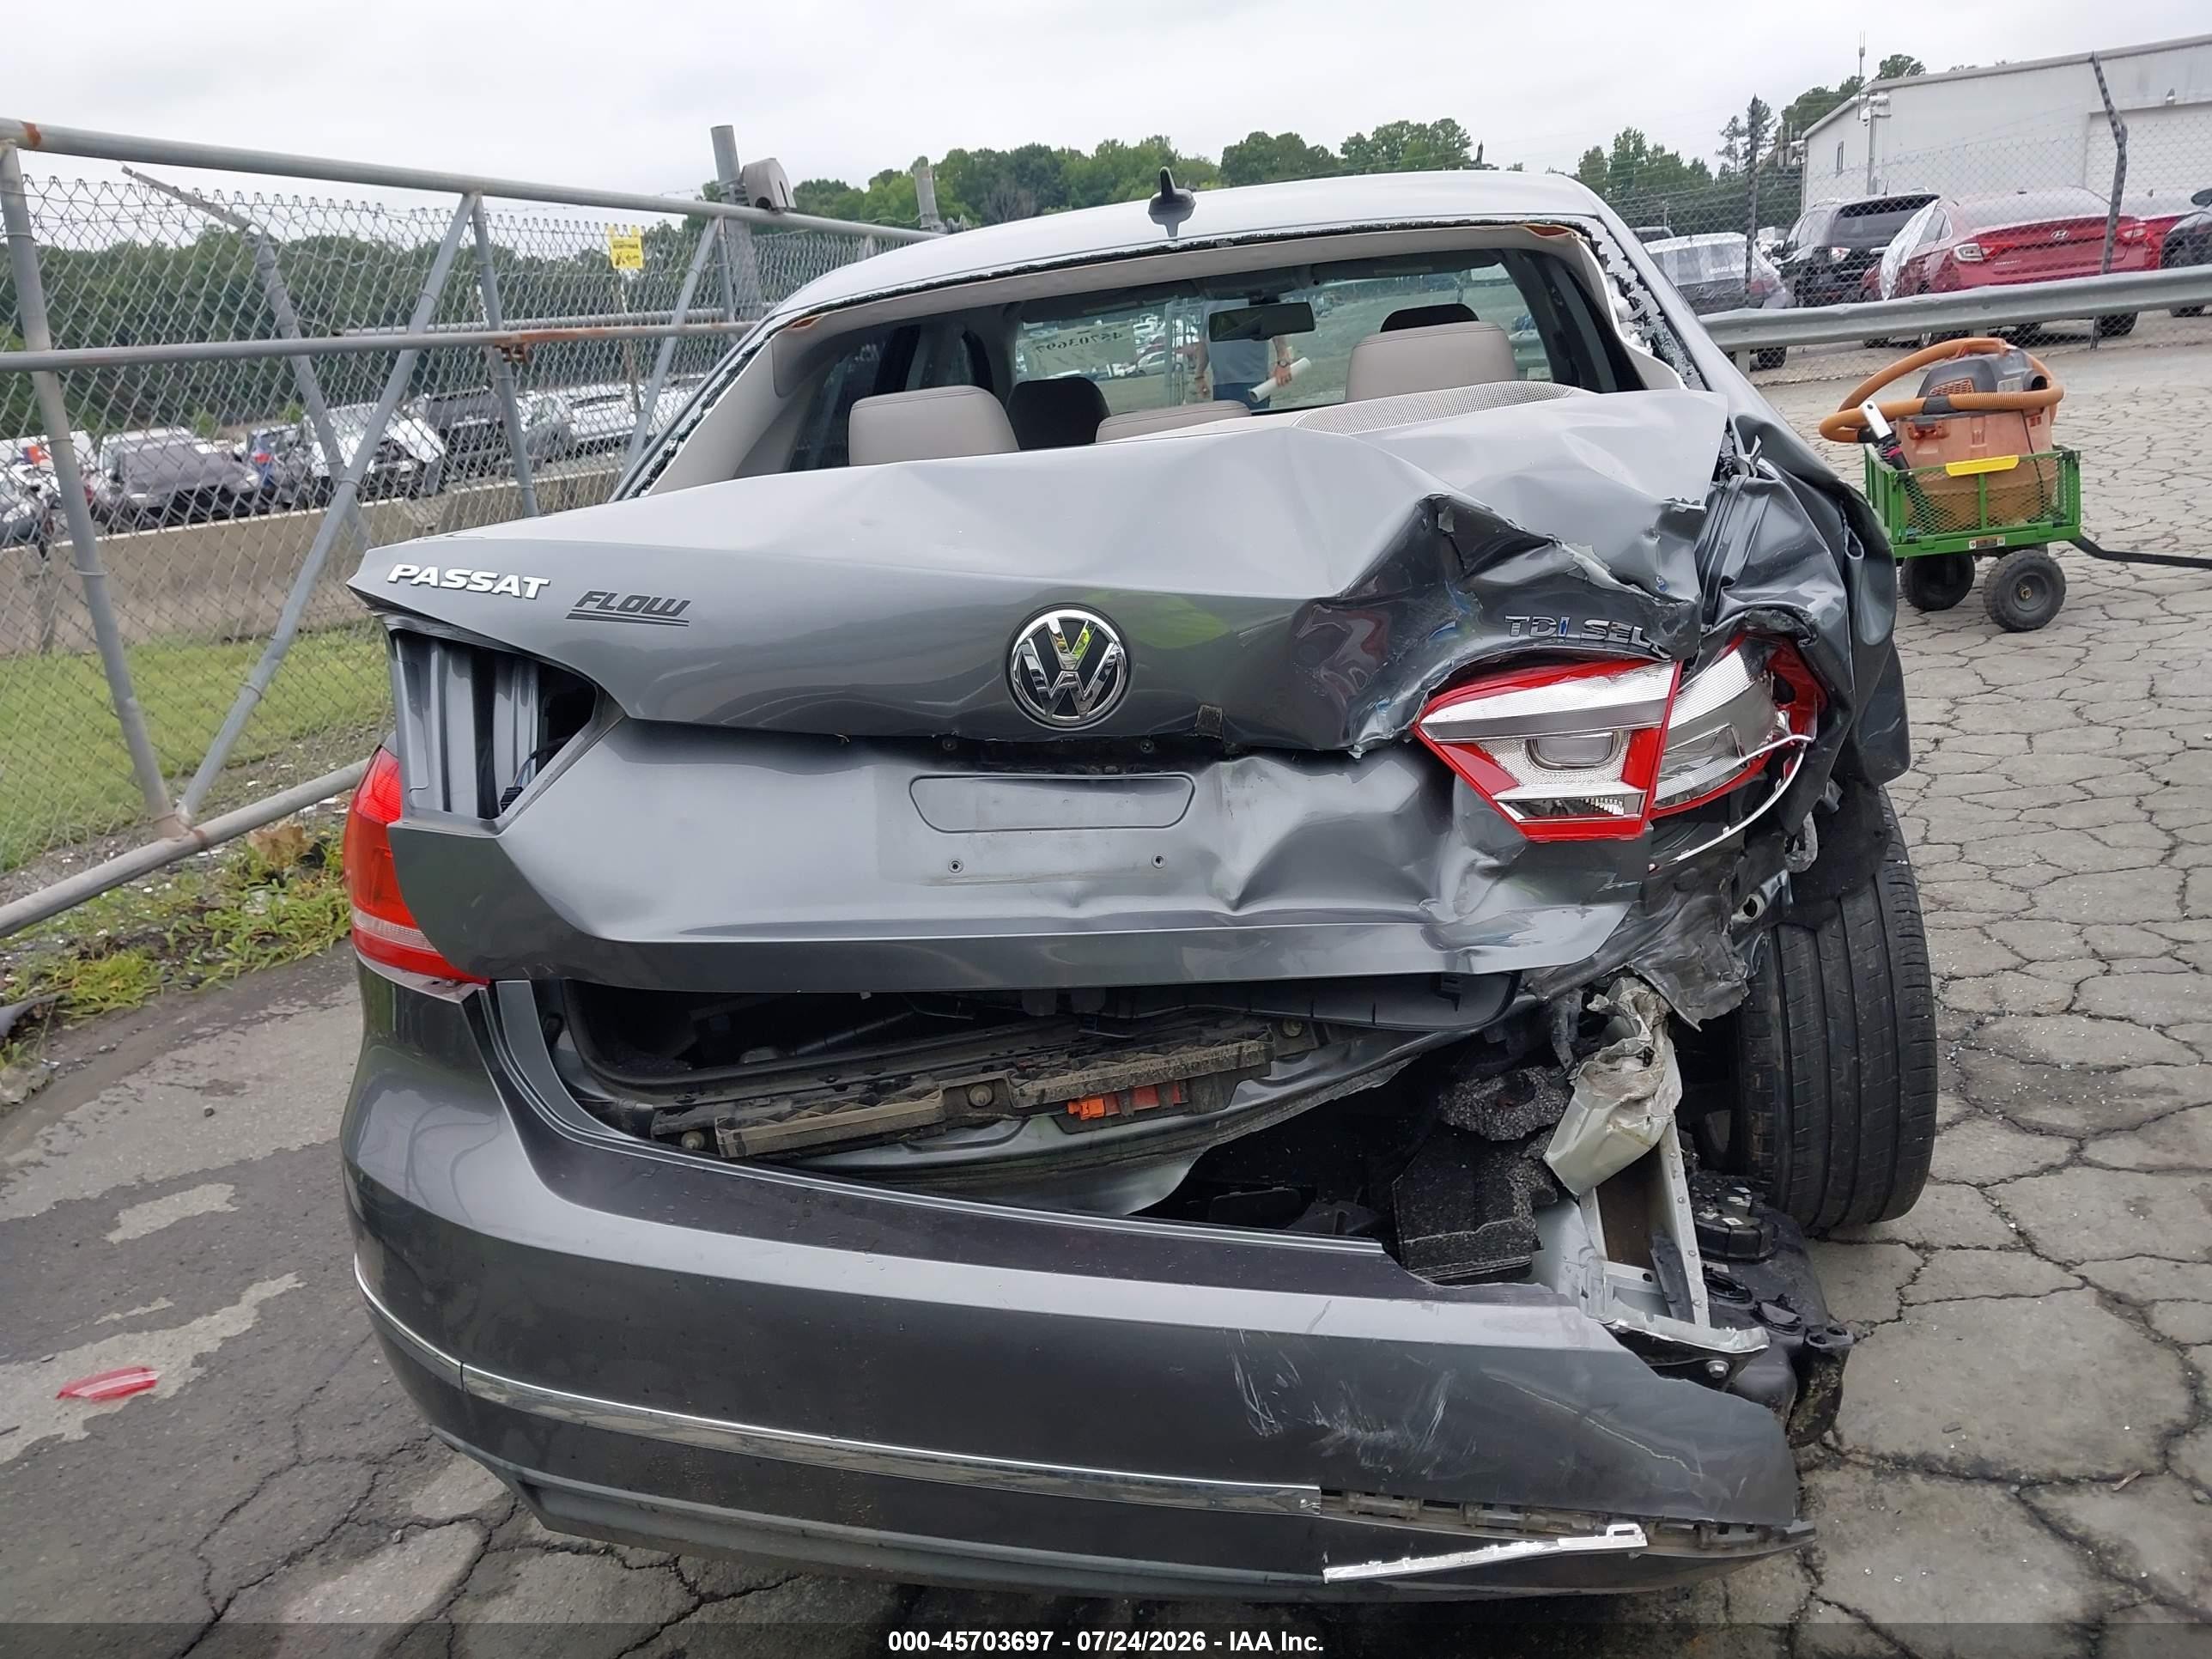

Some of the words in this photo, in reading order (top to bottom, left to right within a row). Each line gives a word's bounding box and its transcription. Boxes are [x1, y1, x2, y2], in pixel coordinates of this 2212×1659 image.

[387, 563, 550, 600] PASSAT
[574, 590, 691, 617] FLOW
[1504, 614, 1571, 638] TDI
[1579, 618, 1652, 648] SEL
